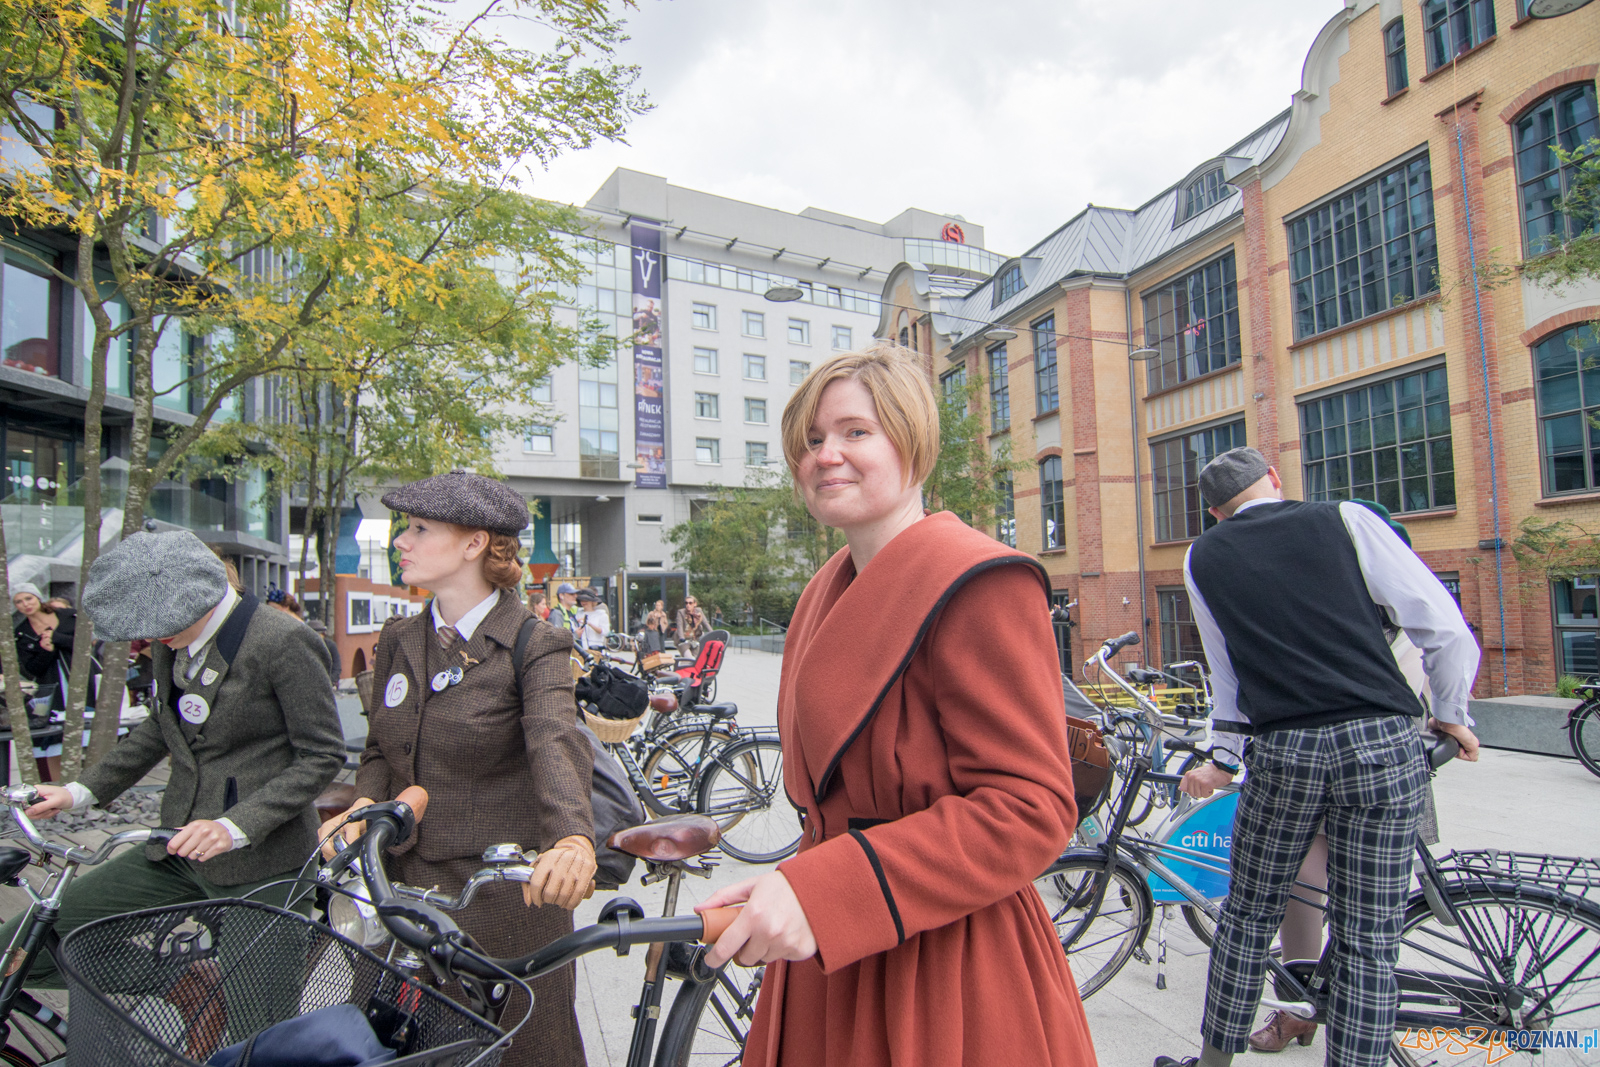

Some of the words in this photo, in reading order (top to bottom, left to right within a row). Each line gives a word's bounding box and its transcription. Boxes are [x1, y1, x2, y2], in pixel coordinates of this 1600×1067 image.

[388, 680, 403, 702] 15
[184, 700, 202, 717] 23
[617, 747, 649, 789] GIANT
[1181, 831, 1209, 848] citi
